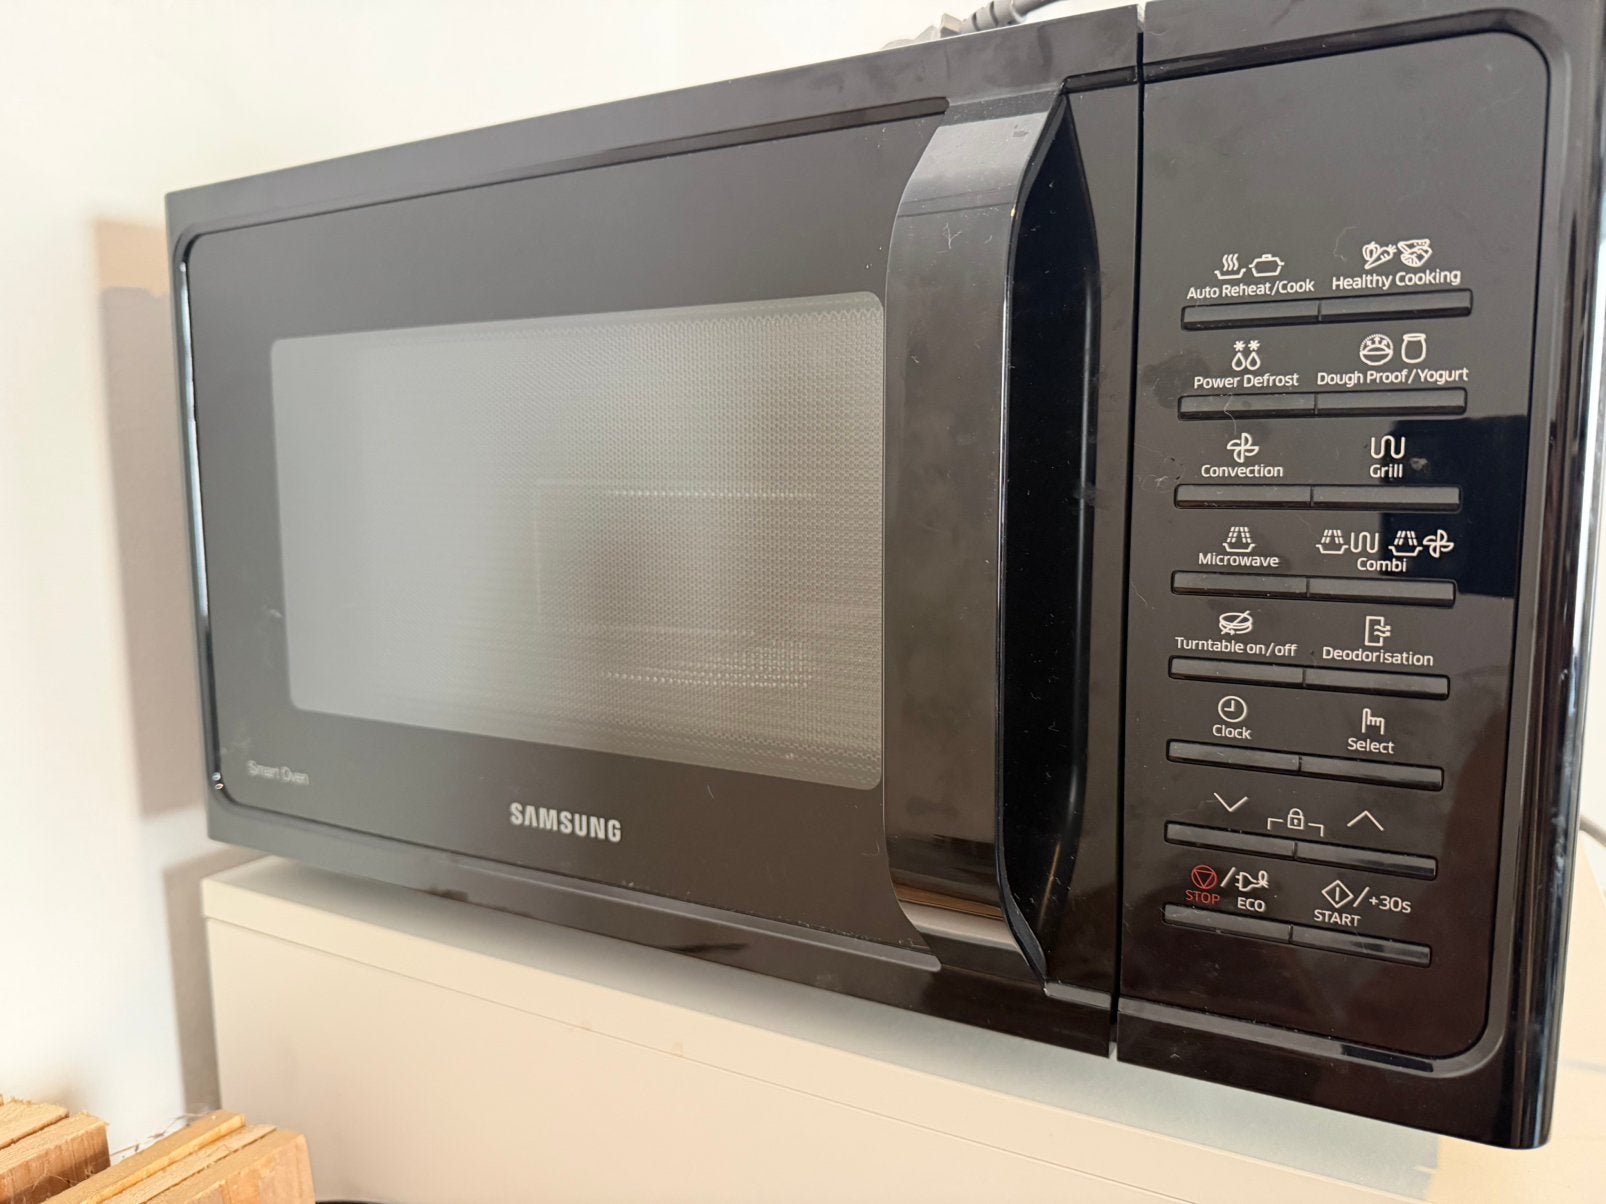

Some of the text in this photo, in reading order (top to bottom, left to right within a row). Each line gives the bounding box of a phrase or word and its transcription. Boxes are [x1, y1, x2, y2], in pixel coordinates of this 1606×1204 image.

[1331, 269, 1461, 290] Healthy Cooking
[1186, 286, 1219, 299] Auto
[1193, 372, 1300, 389] Power Defrost
[1317, 371, 1364, 388] Dough
[1200, 464, 1284, 478] Convection
[1369, 463, 1404, 479] Grill
[1198, 552, 1280, 568] Microwave
[1356, 557, 1408, 573] Combi
[1175, 637, 1298, 657] Turntable on/off
[1322, 647, 1434, 666] Deodorisation
[1212, 724, 1252, 740] Clock
[1347, 738, 1395, 754] Select
[509, 802, 622, 842] SAMSUNG
[1185, 889, 1221, 905] STOP
[1237, 897, 1266, 913] ECO
[1313, 909, 1362, 927] START
